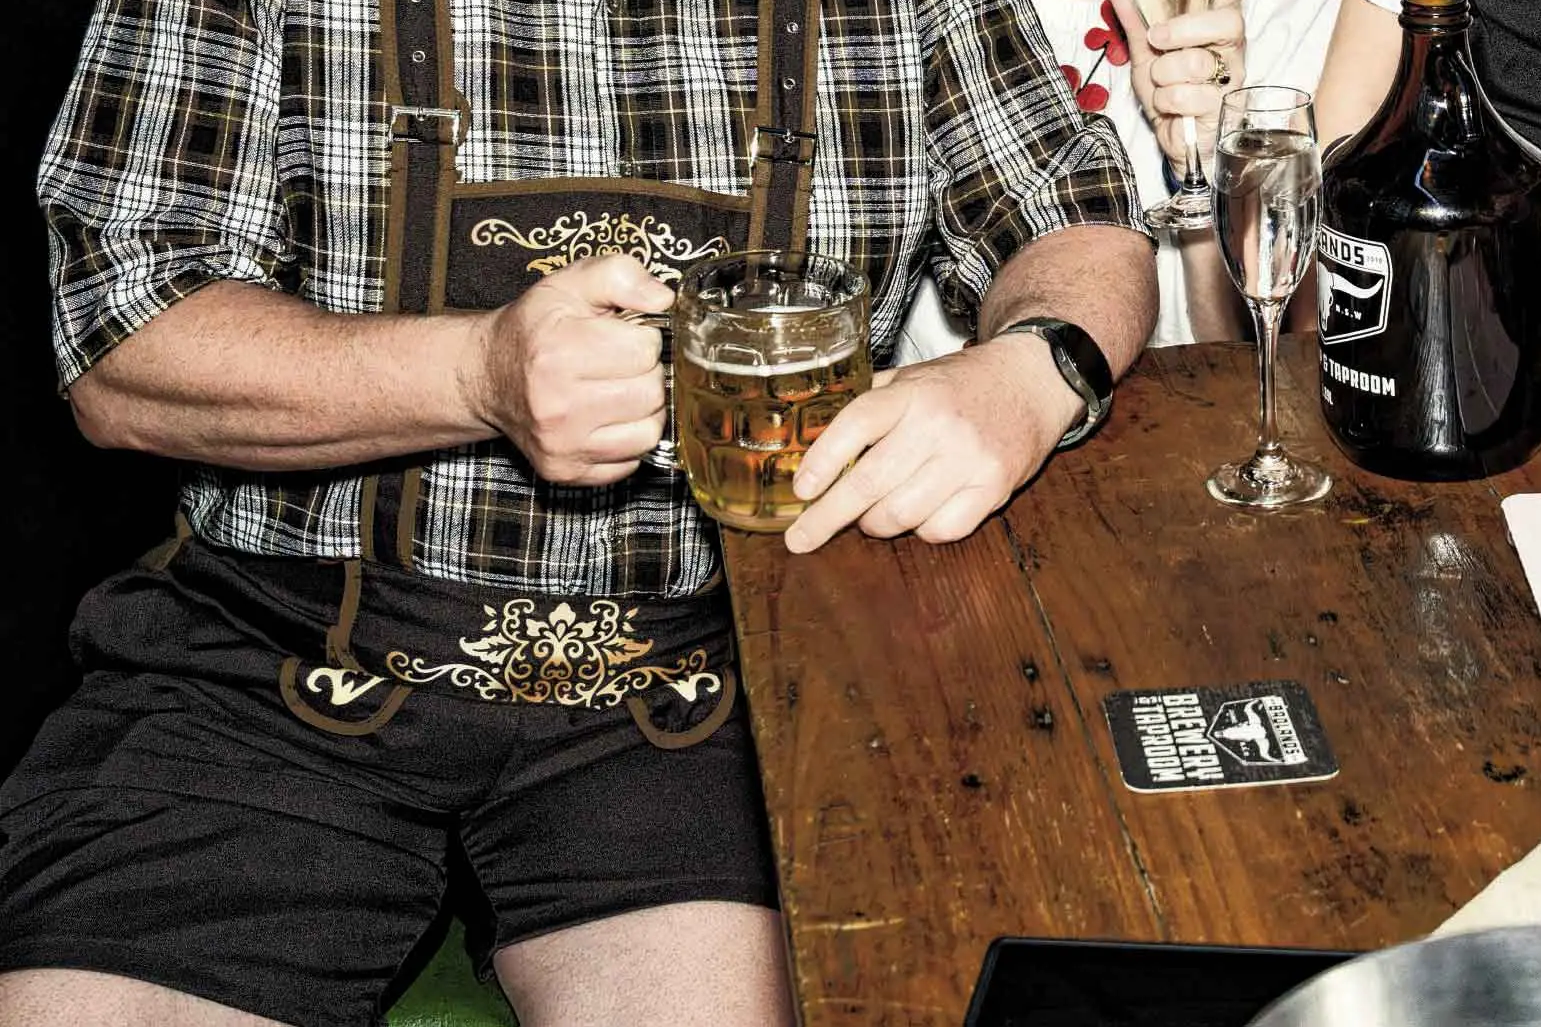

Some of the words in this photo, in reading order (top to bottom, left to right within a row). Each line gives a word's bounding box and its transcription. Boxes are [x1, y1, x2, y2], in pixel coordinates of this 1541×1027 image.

[1317, 231, 1364, 266] ANDS
[1329, 358, 1395, 397] TAPROOM
[1132, 704, 1186, 783] TAPROOM
[1162, 694, 1224, 780] BREWERY
[1269, 705, 1299, 754] BADLANDS
